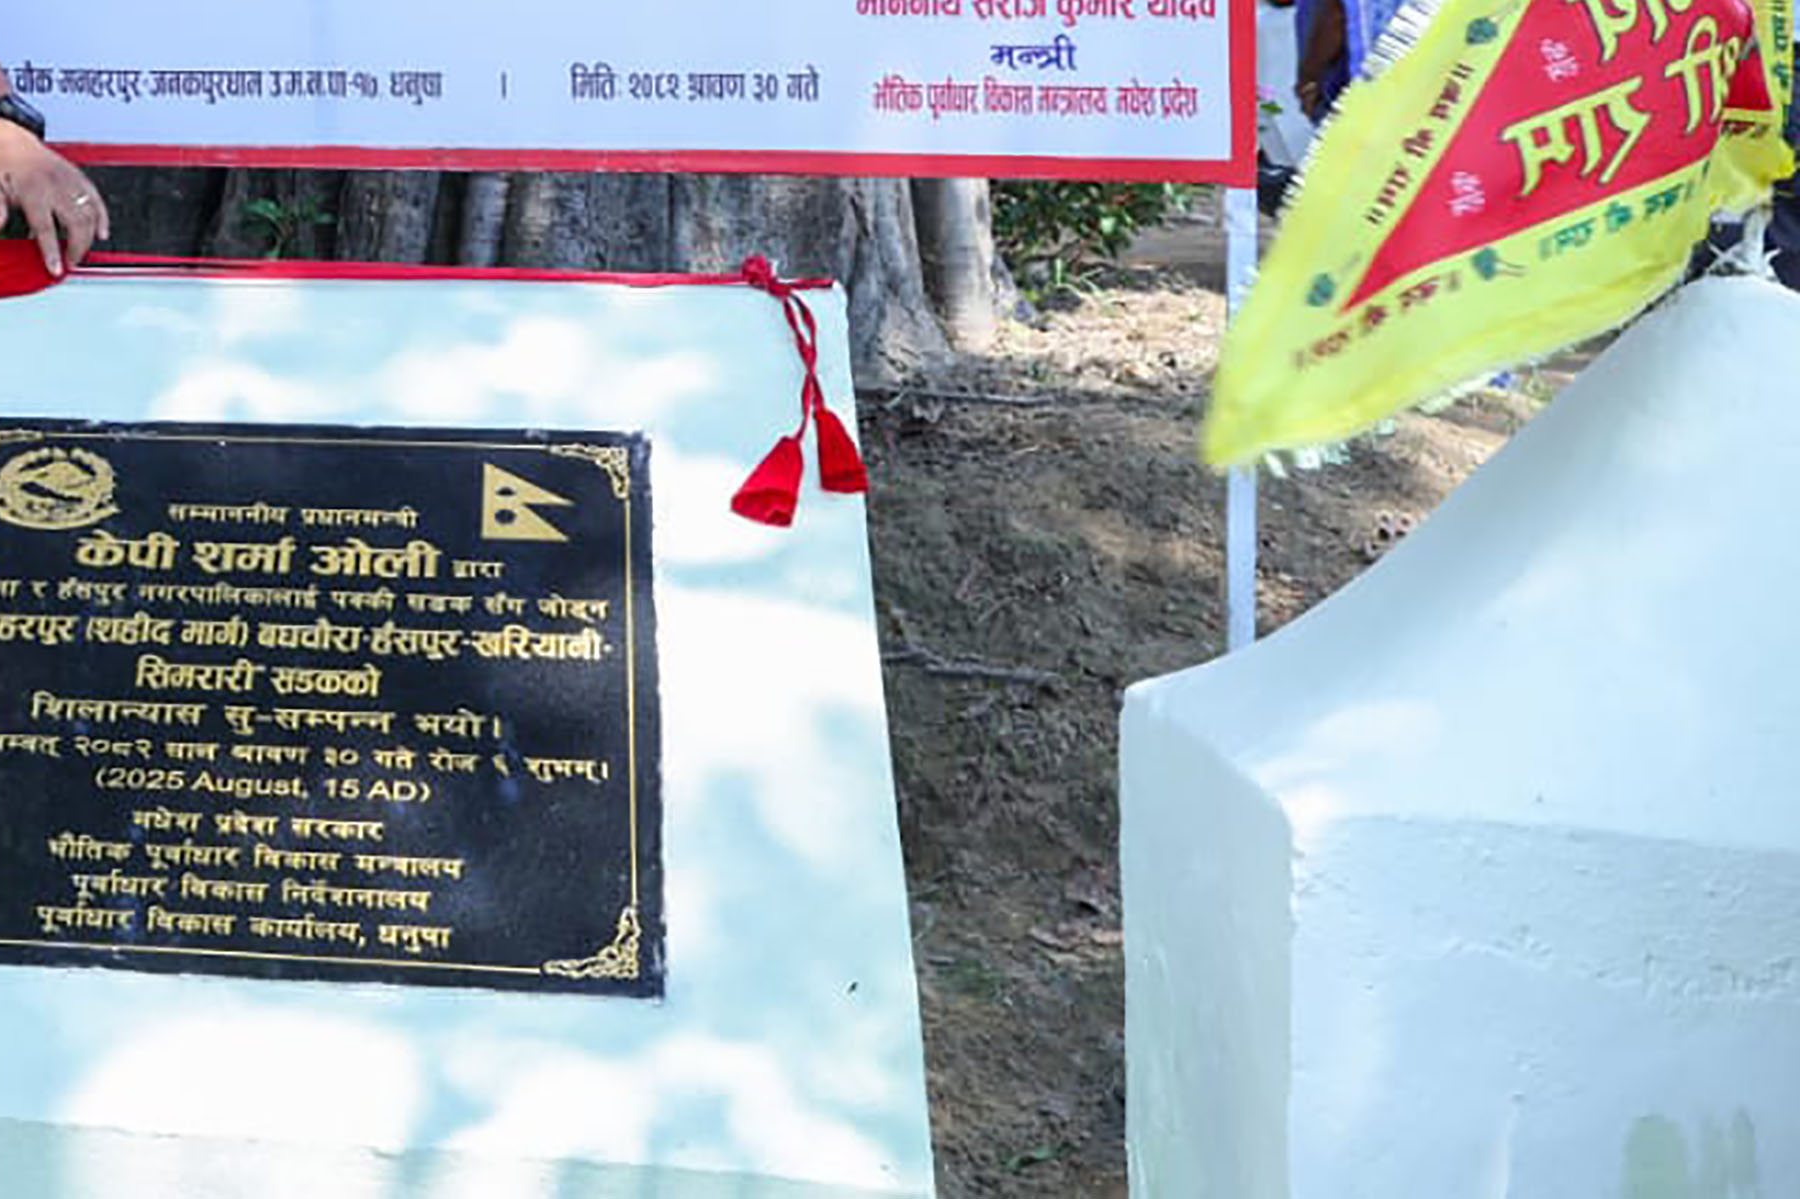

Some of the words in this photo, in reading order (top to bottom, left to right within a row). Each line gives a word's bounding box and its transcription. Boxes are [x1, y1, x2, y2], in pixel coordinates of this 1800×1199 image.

[990, 34, 1077, 71] मन्त्री
[628, 72, 680, 100] २०८२
[753, 73, 778, 102] ३०
[786, 63, 820, 101] गते
[168, 502, 290, 525] सम्माननीय
[73, 529, 180, 570] केपी
[191, 536, 297, 574] शर्मा
[308, 538, 443, 579] ओली
[135, 653, 266, 691] सिमरारी
[270, 662, 382, 698] सडकको
[30, 689, 208, 726] शिलान्यास
[94, 767, 185, 791] (2025
[323, 779, 361, 799] 15
[365, 780, 432, 803] AD)
